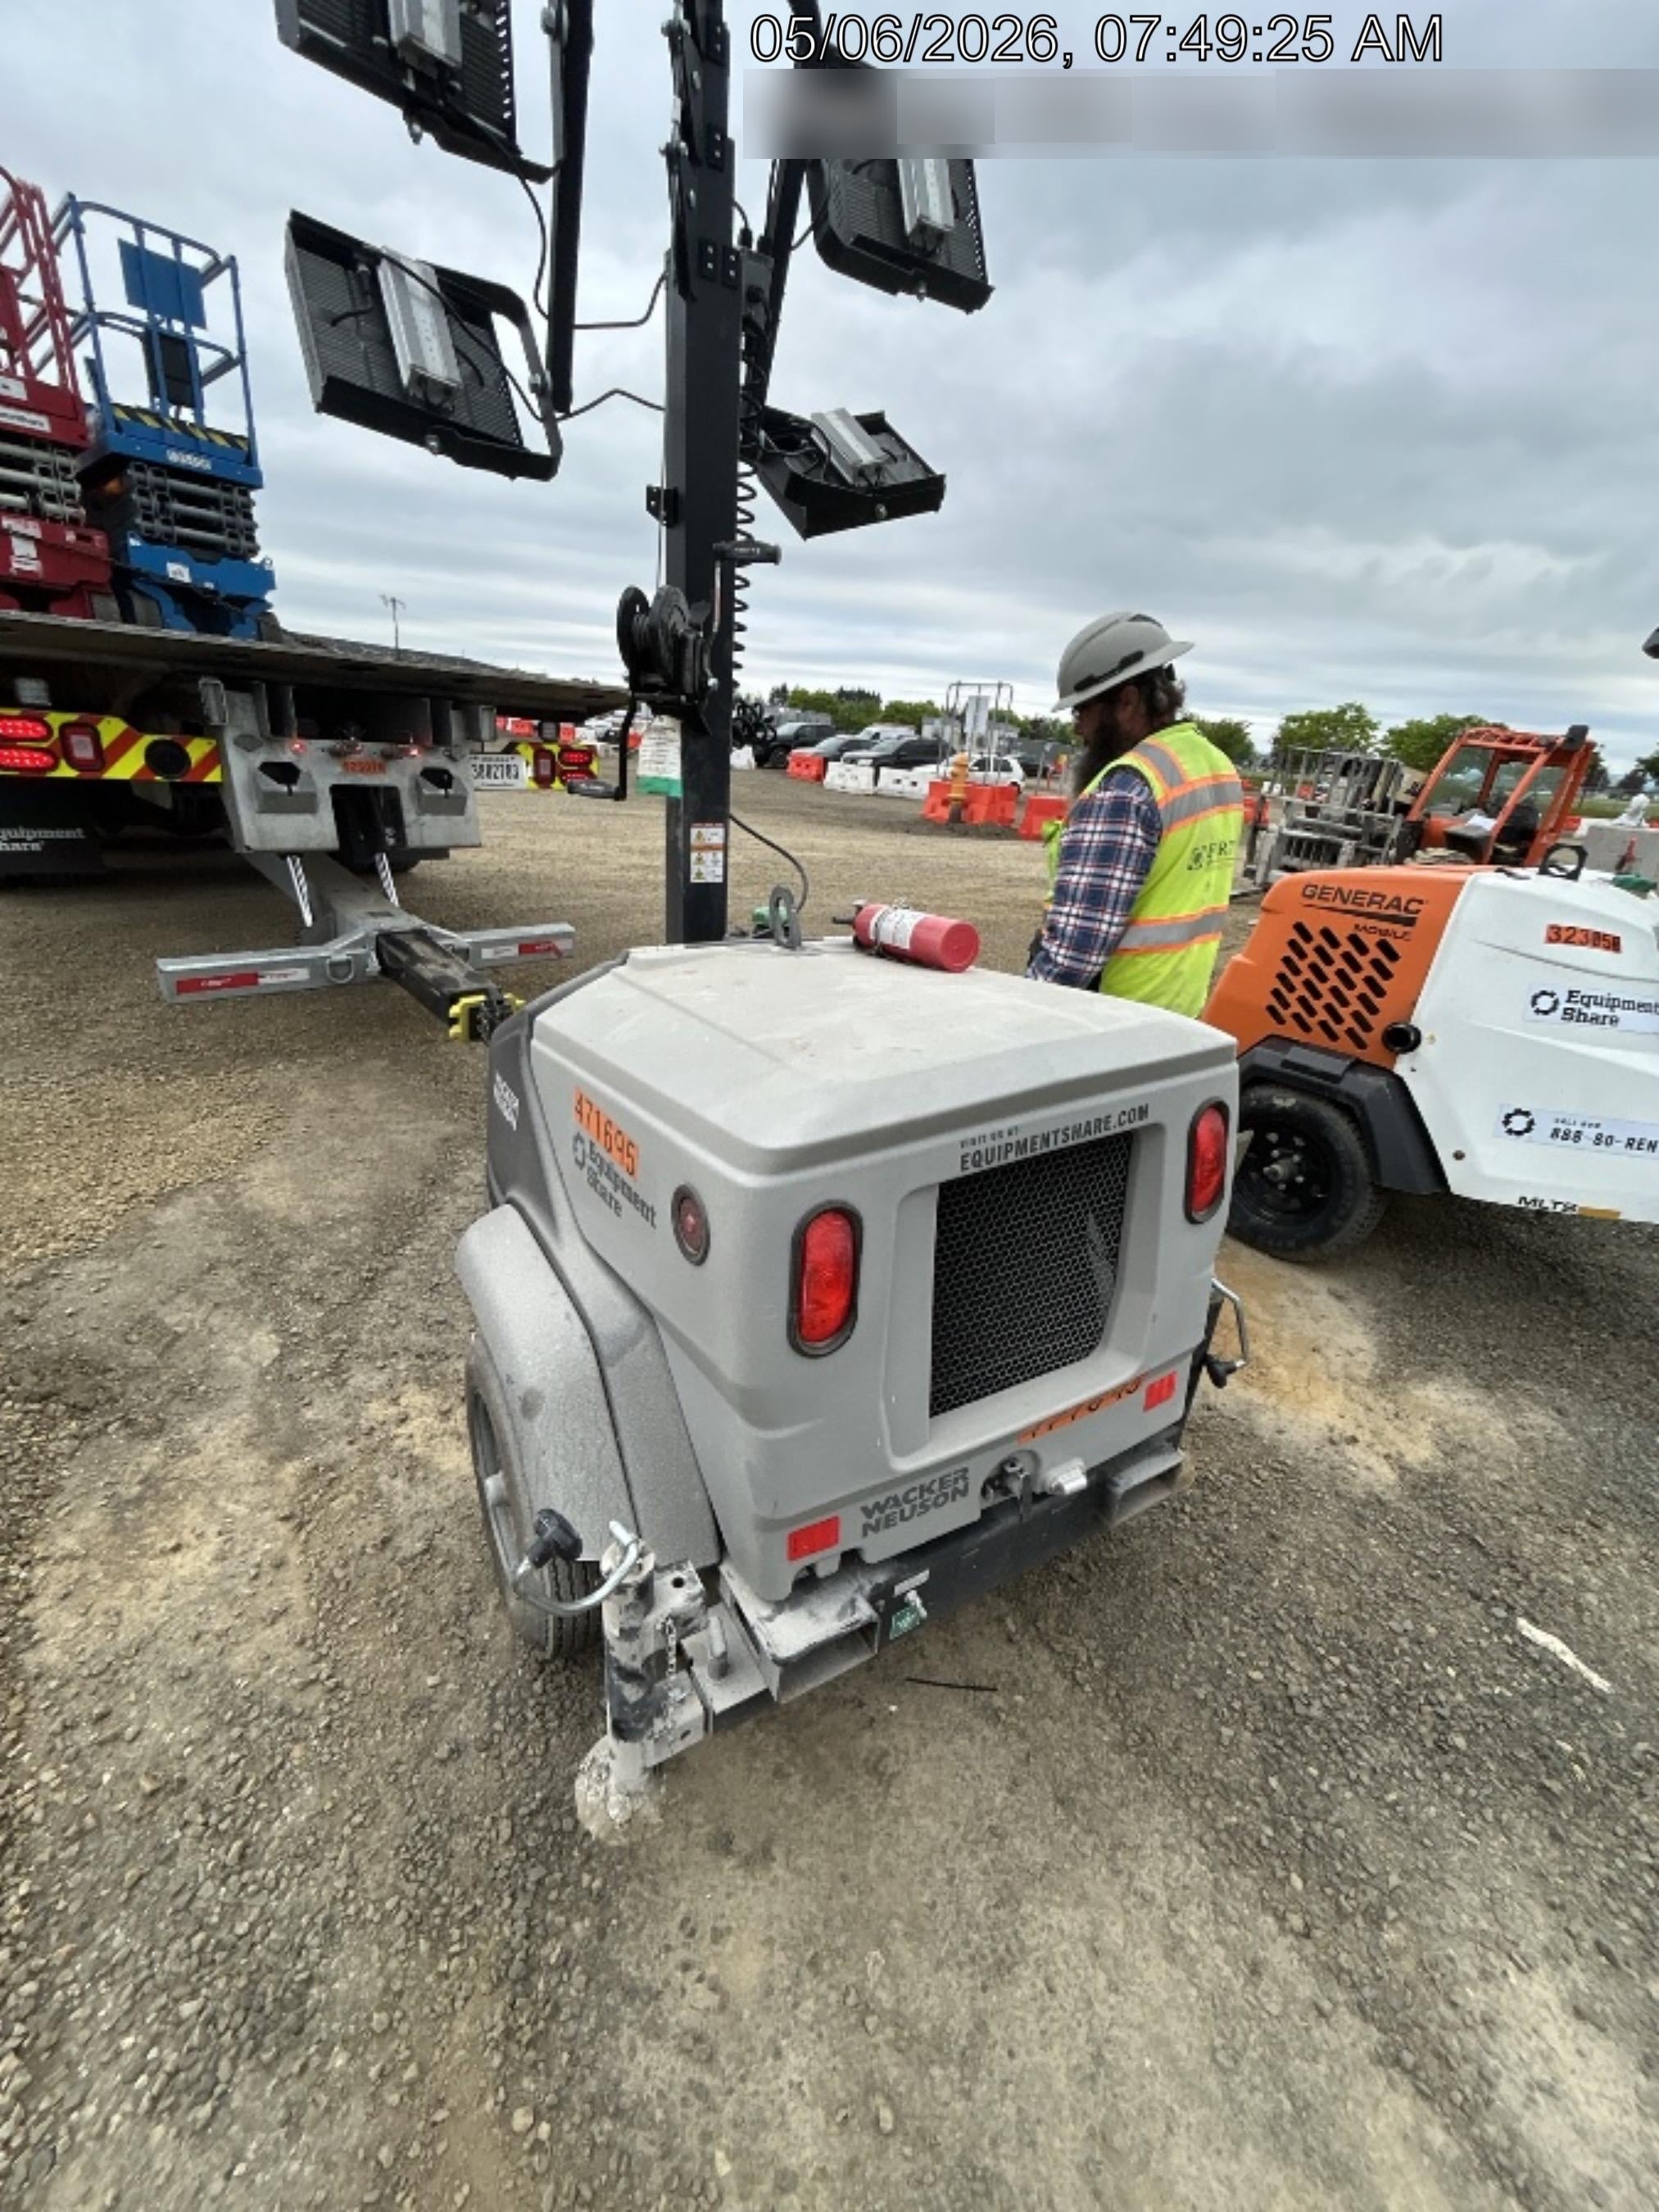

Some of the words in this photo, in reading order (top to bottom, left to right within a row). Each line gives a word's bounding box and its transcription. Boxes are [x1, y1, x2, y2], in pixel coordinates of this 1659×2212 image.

[1302, 884, 1426, 915] GENERAC
[1561, 1008, 1620, 1027] Share
[574, 1093, 636, 1177] 471695
[960, 1103, 1149, 1172] EQUIPMENTSHARE.COM
[587, 1164, 623, 1218] Share
[588, 1140, 657, 1230] Equipment
[860, 1466, 968, 1520] WACKER
[862, 1478, 968, 1538] NEUSON
